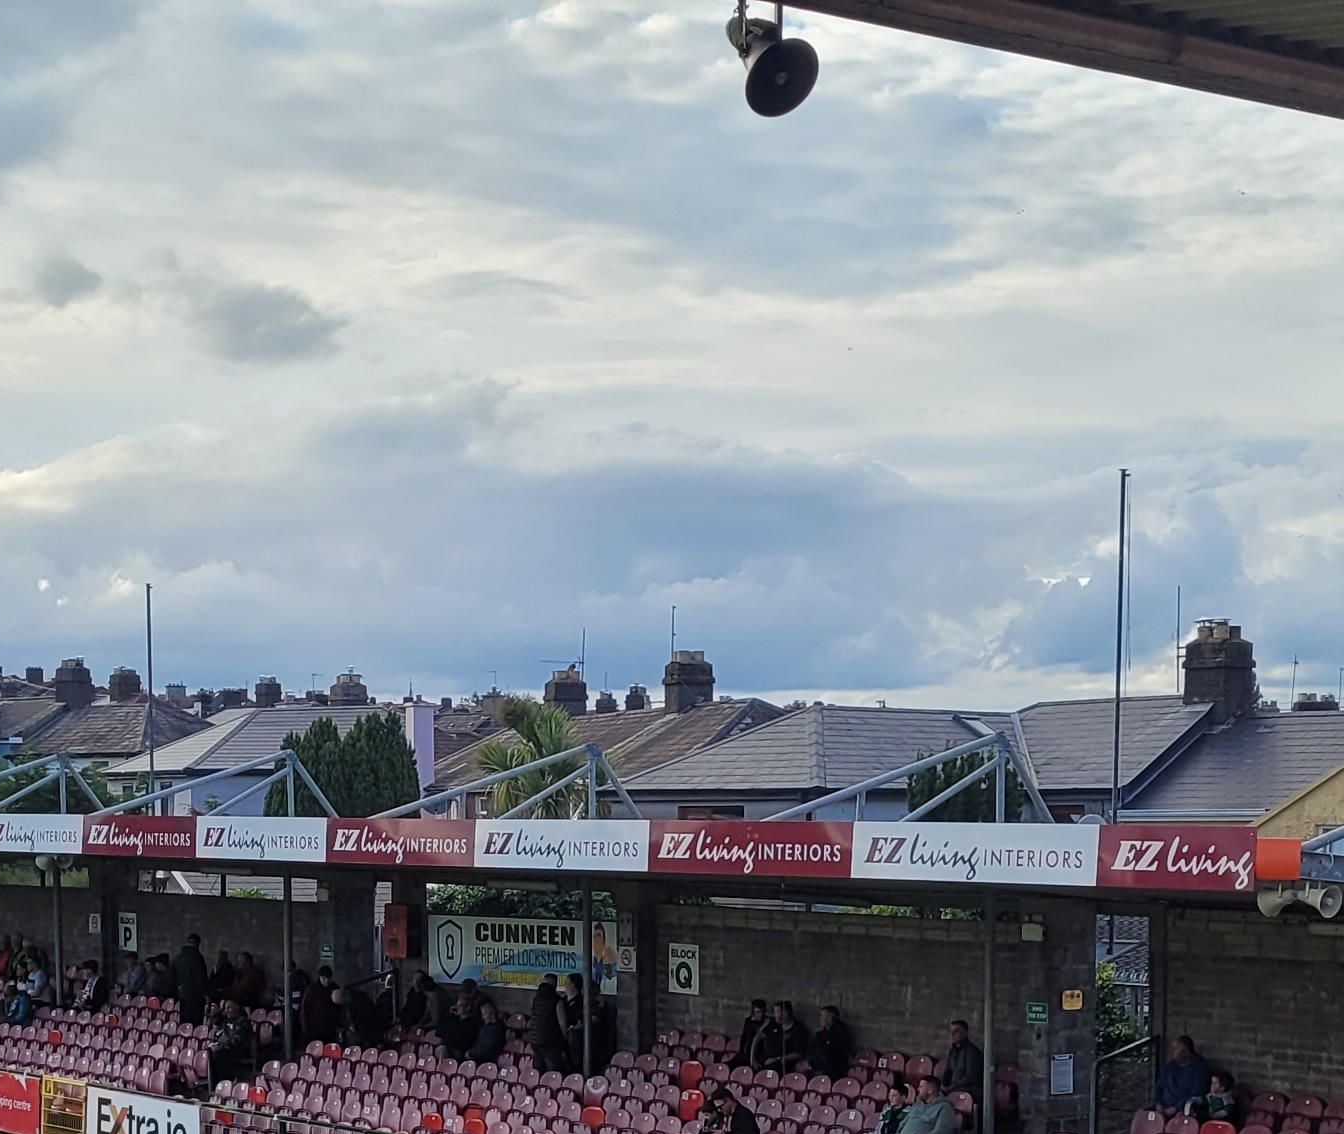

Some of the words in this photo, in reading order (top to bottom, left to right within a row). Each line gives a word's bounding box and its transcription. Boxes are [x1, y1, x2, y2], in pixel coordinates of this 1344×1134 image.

[5, 821, 36, 850] living
[36, 829, 77, 843] INTERIORS
[87, 823, 110, 845] EZ
[109, 824, 143, 856] living
[144, 832, 191, 847] INTERIORS
[203, 827, 226, 847] EZ
[227, 824, 266, 858] living
[267, 835, 319, 850] INTERIORS
[333, 828, 361, 851] EZ
[361, 826, 406, 863] living
[406, 837, 467, 854] INTERIORS
[483, 831, 515, 855] EZ
[516, 828, 567, 868] living
[567, 840, 639, 858] INTERIORS
[657, 833, 696, 860] EZ
[695, 829, 758, 874] living
[758, 843, 841, 862] INTERIORS
[864, 837, 907, 865] EZ
[909, 832, 982, 880] living
[983, 848, 1084, 870] INTERIORS
[1111, 840, 1165, 872] EZ
[1166, 835, 1254, 890] living
[124, 927, 132, 947] P
[475, 922, 575, 946] CUNNEEN
[475, 947, 515, 965] PREMIER
[517, 949, 577, 970] LOCKSMITHS
[671, 948, 697, 960] BLOCK
[676, 961, 693, 989] Q
[13, 1100, 32, 1111] centre
